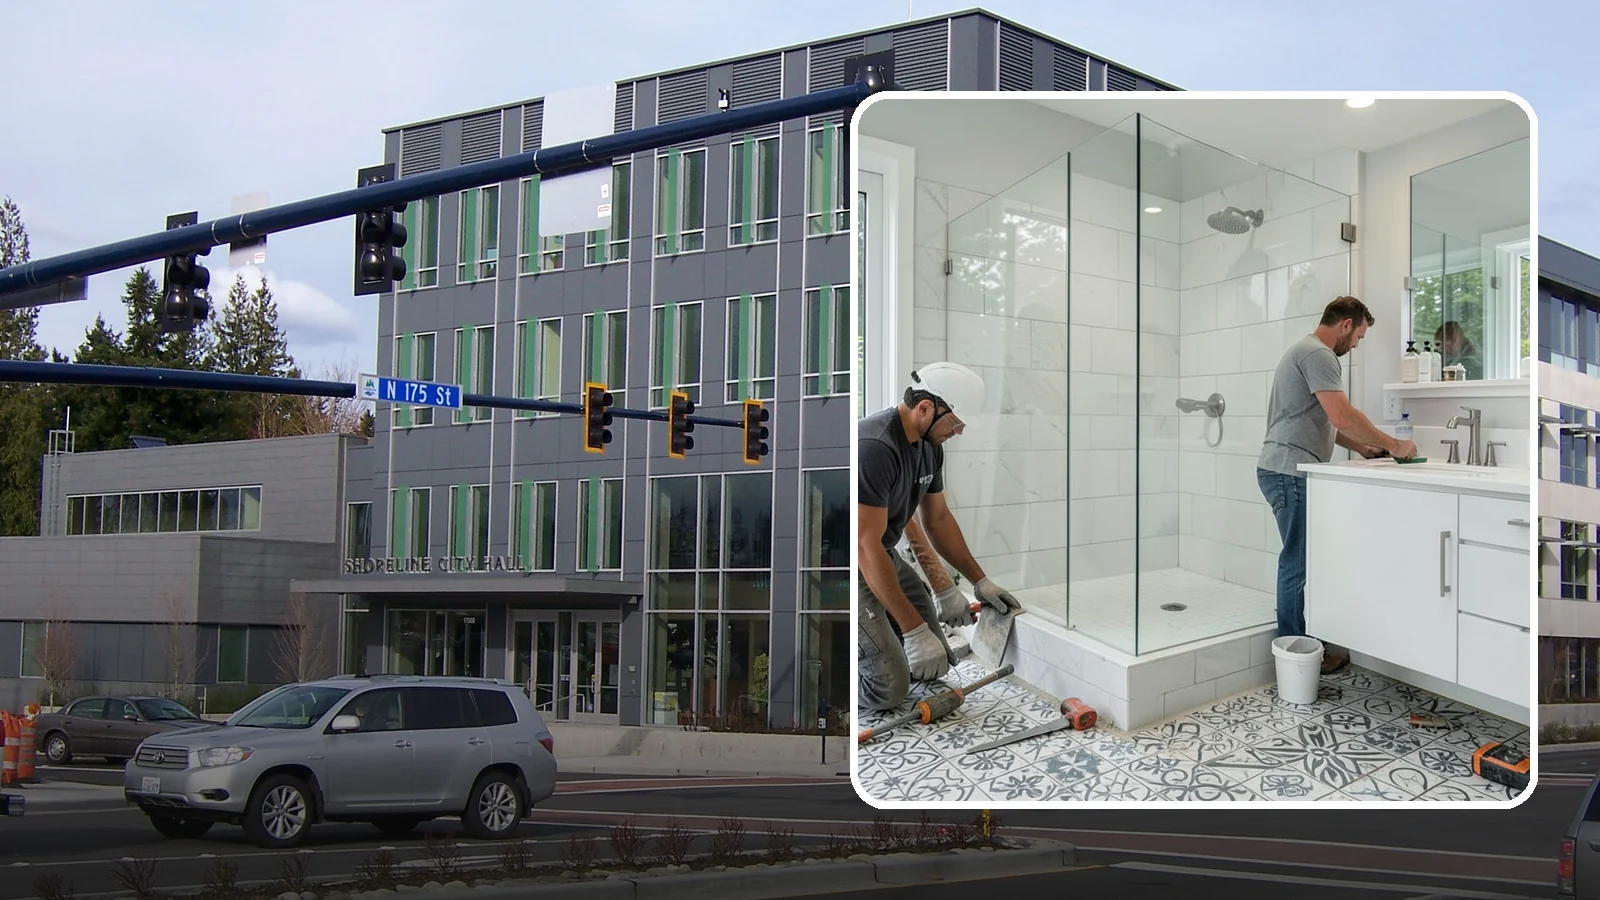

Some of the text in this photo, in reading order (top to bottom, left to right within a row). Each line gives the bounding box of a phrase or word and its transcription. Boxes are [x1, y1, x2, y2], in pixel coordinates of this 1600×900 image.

[387, 380, 451, 405] N 175 St
[344, 555, 525, 574] SHORELINE CITY HALL
